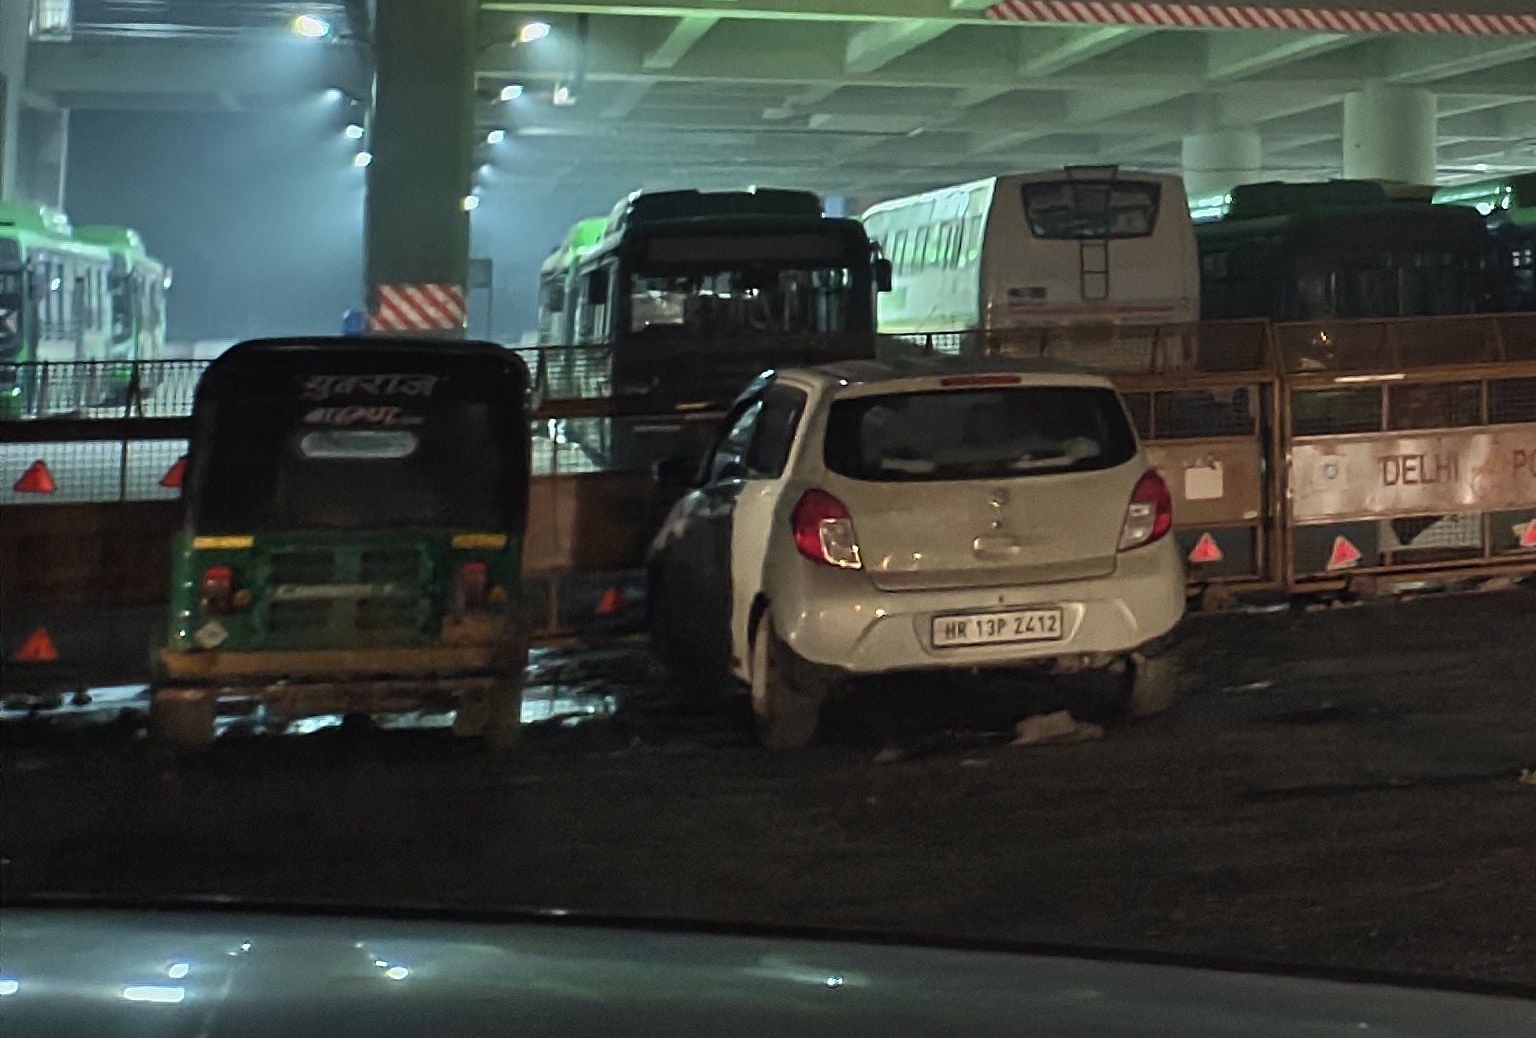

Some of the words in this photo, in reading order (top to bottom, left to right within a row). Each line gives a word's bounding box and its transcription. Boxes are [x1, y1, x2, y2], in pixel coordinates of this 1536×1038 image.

[1381, 453, 1460, 486] DELHI
[944, 620, 968, 641] HR
[976, 617, 1009, 638] 13P
